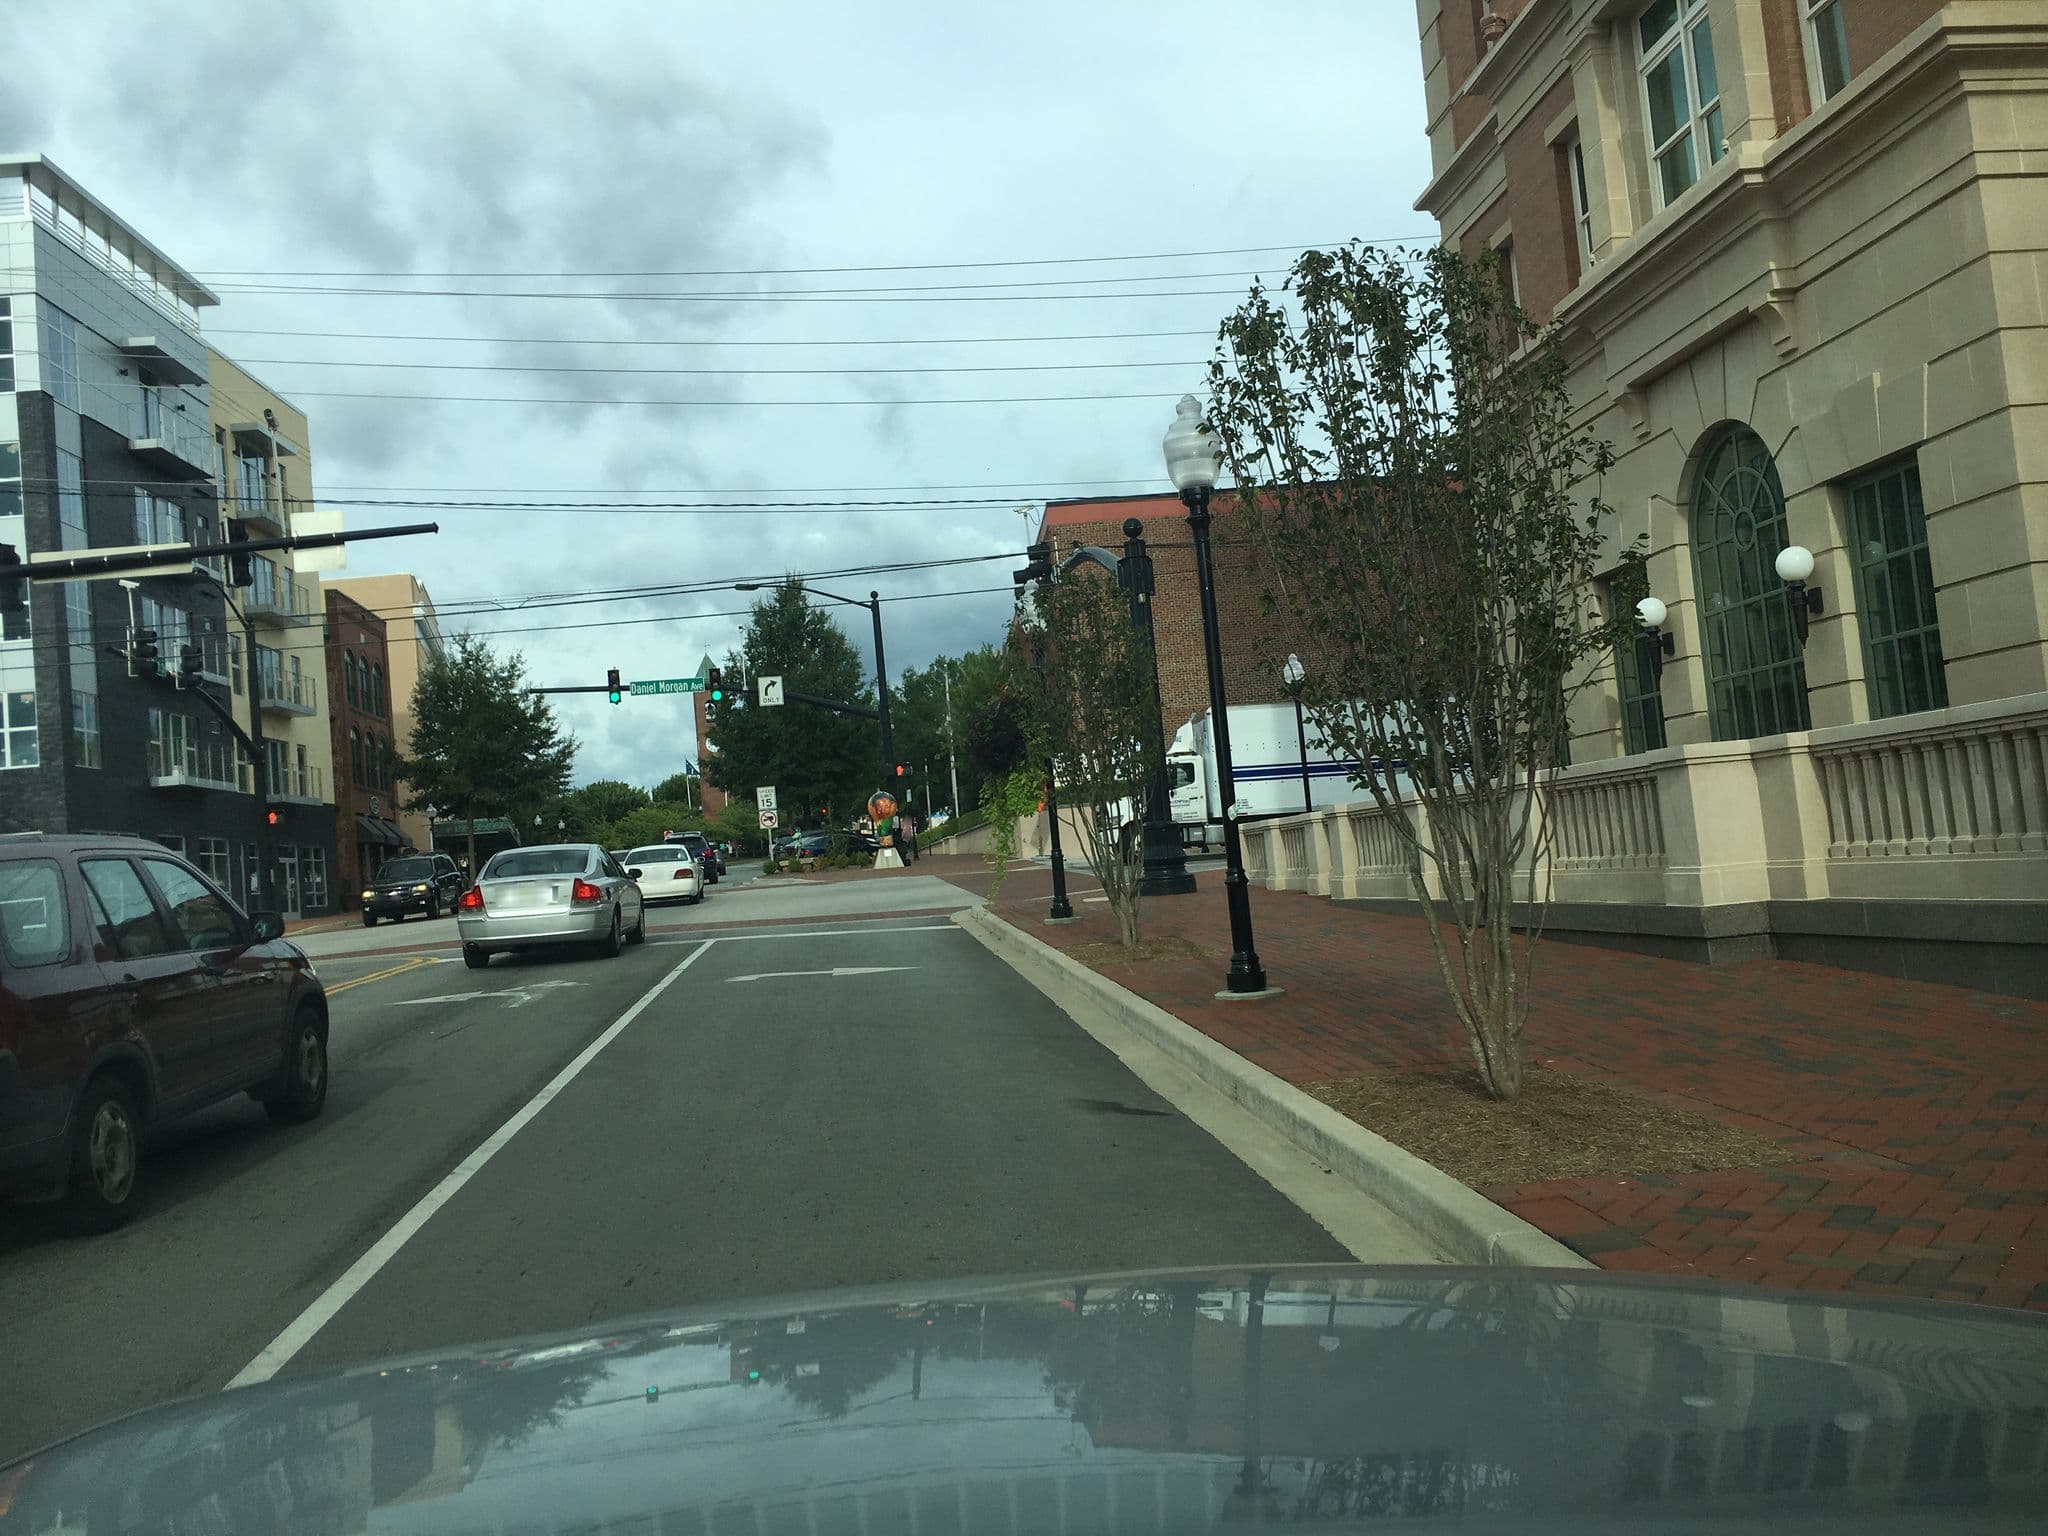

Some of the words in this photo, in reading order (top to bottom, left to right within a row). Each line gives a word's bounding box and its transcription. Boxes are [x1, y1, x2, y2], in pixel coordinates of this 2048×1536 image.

[631, 682, 657, 695] Daniel
[659, 681, 689, 693] Morgan
[690, 682, 703, 691] Ave
[761, 799, 772, 807] 15
